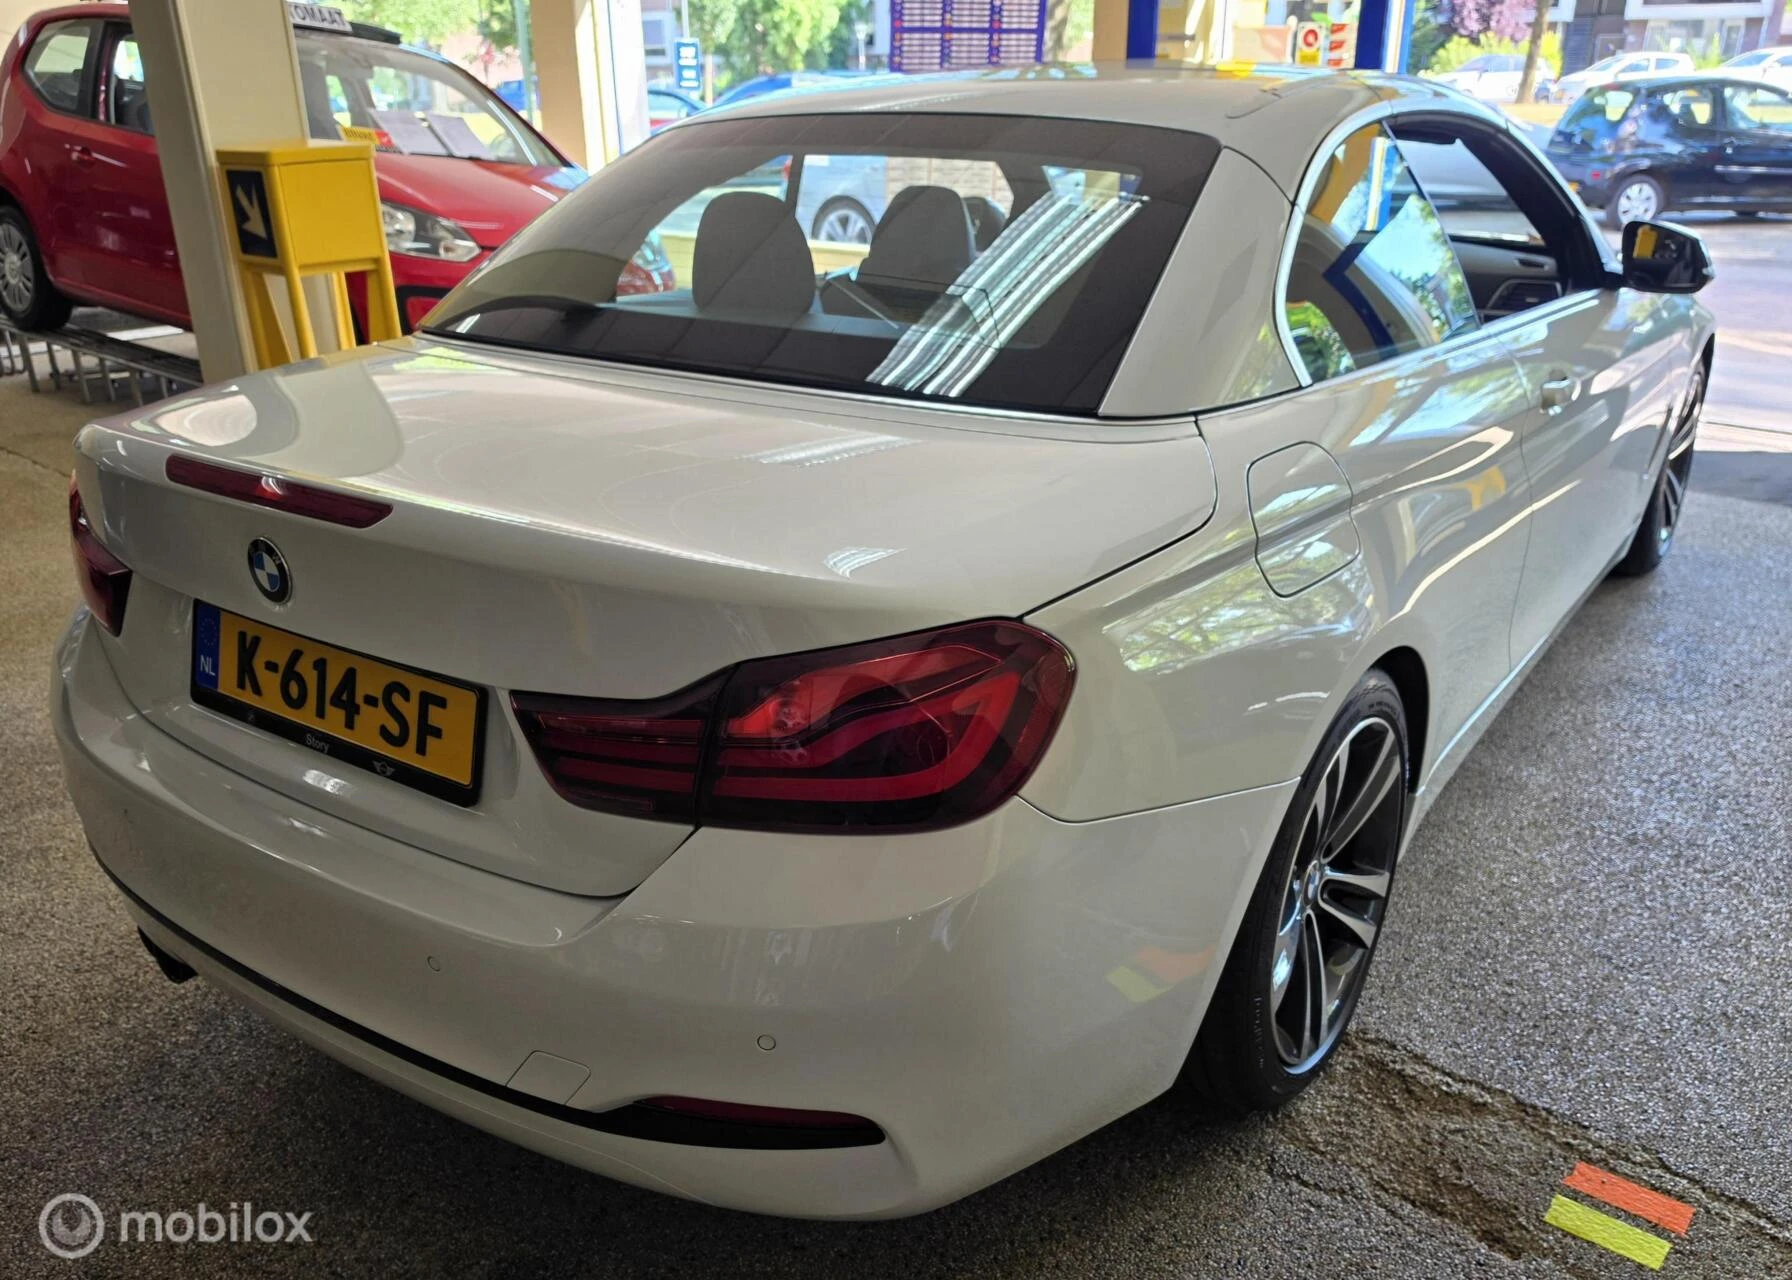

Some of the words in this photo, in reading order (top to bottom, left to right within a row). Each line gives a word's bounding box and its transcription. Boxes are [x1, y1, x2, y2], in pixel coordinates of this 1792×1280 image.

[200, 655, 216, 676] NL
[236, 630, 448, 757] K-614-SF
[305, 734, 330, 754] Story
